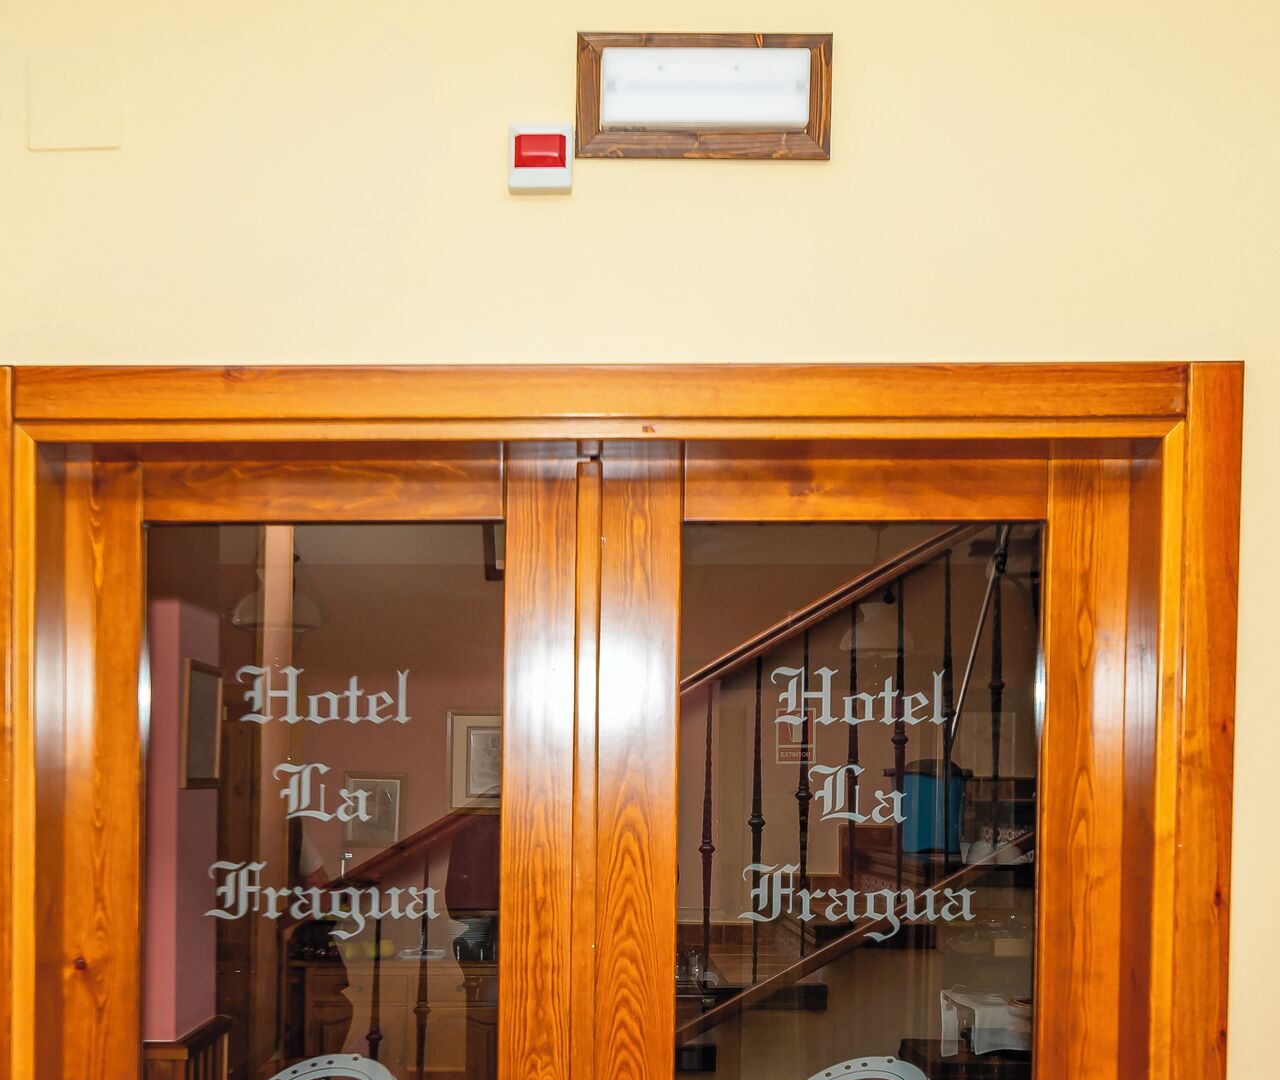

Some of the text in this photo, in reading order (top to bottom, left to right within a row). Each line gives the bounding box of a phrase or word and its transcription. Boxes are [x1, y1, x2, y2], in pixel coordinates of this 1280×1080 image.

[236, 659, 410, 725] Hotel
[771, 665, 950, 727] Hotel
[273, 762, 373, 823] La
[807, 764, 908, 825] La
[205, 860, 441, 938] Fragua
[738, 862, 977, 943] Fragua
